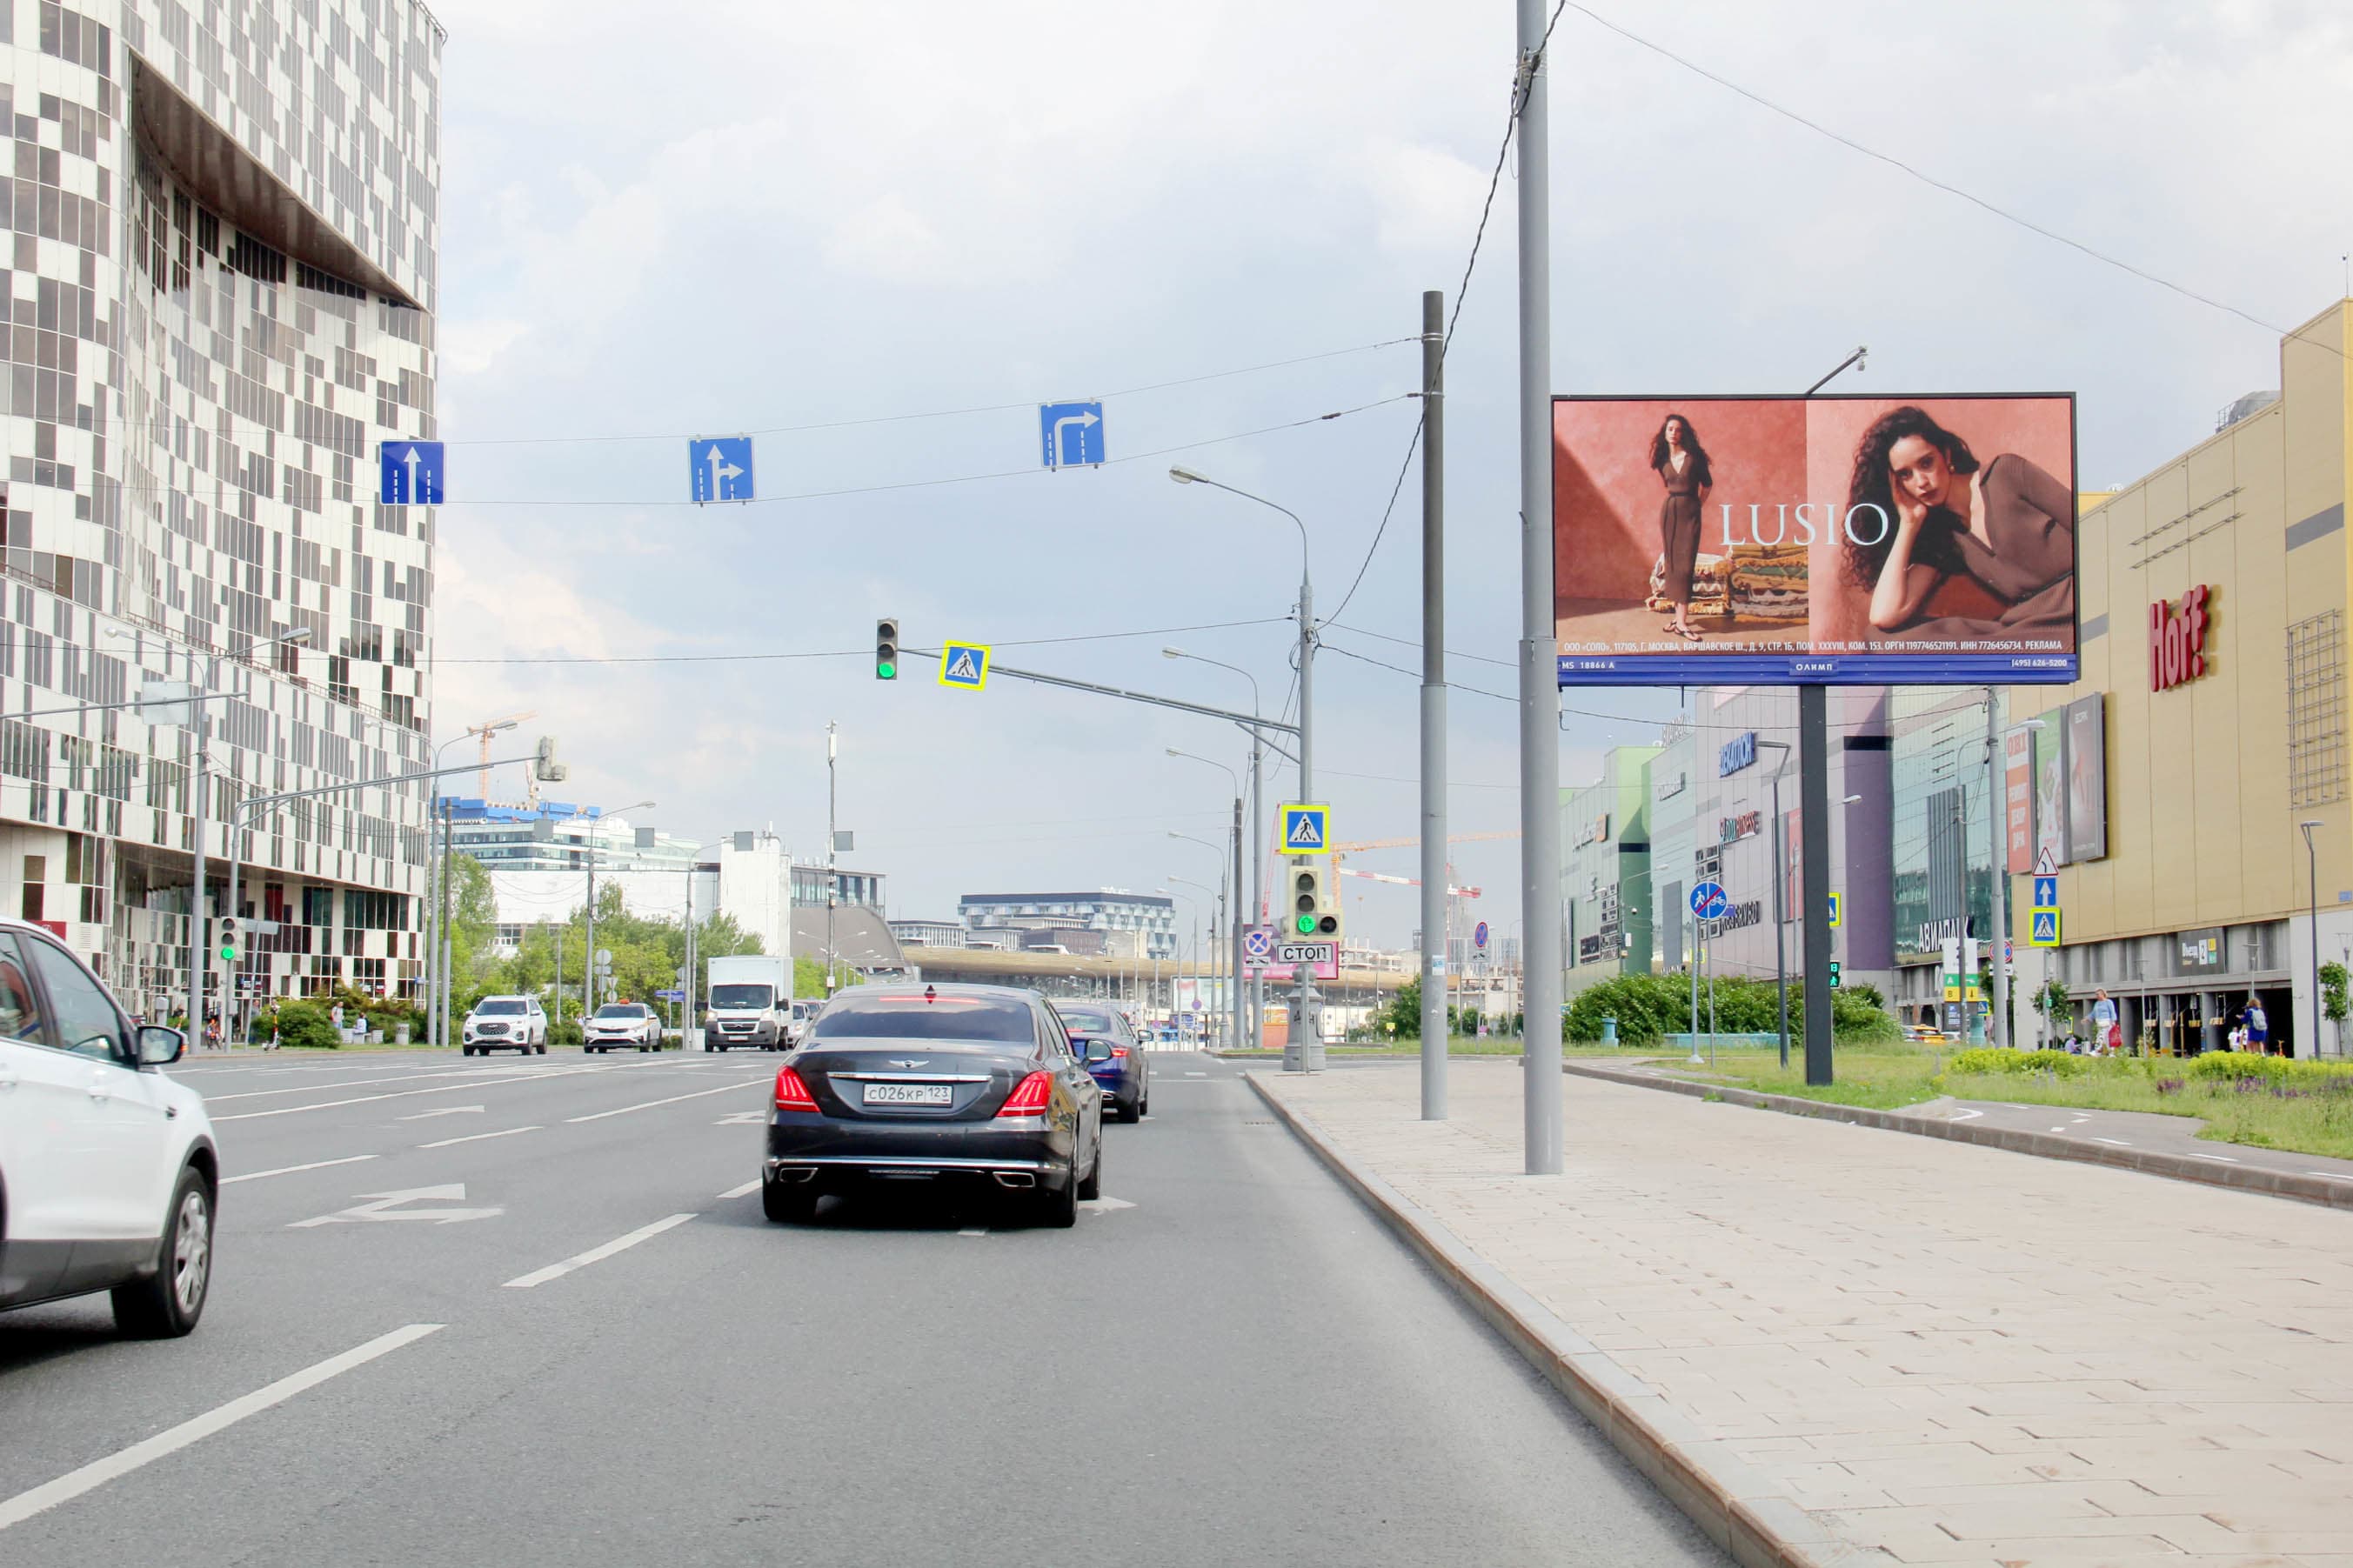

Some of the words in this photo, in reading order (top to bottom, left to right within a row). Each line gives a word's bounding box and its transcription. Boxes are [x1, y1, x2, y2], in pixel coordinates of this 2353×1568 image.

[1719, 502, 1889, 547] LUSIO
[1564, 642, 1581, 651] ООО
[1614, 642, 1638, 652] 117105,
[1648, 642, 1681, 652] МОСКВА,
[1683, 641, 1734, 651] ВАРШАВСКОЕ
[1961, 641, 1977, 651] ИНН
[2025, 640, 2062, 651] РЕКЛАМА
[1562, 661, 1574, 670] MS
[1284, 947, 1327, 960] СТОП
[927, 1087, 948, 1098] 123
